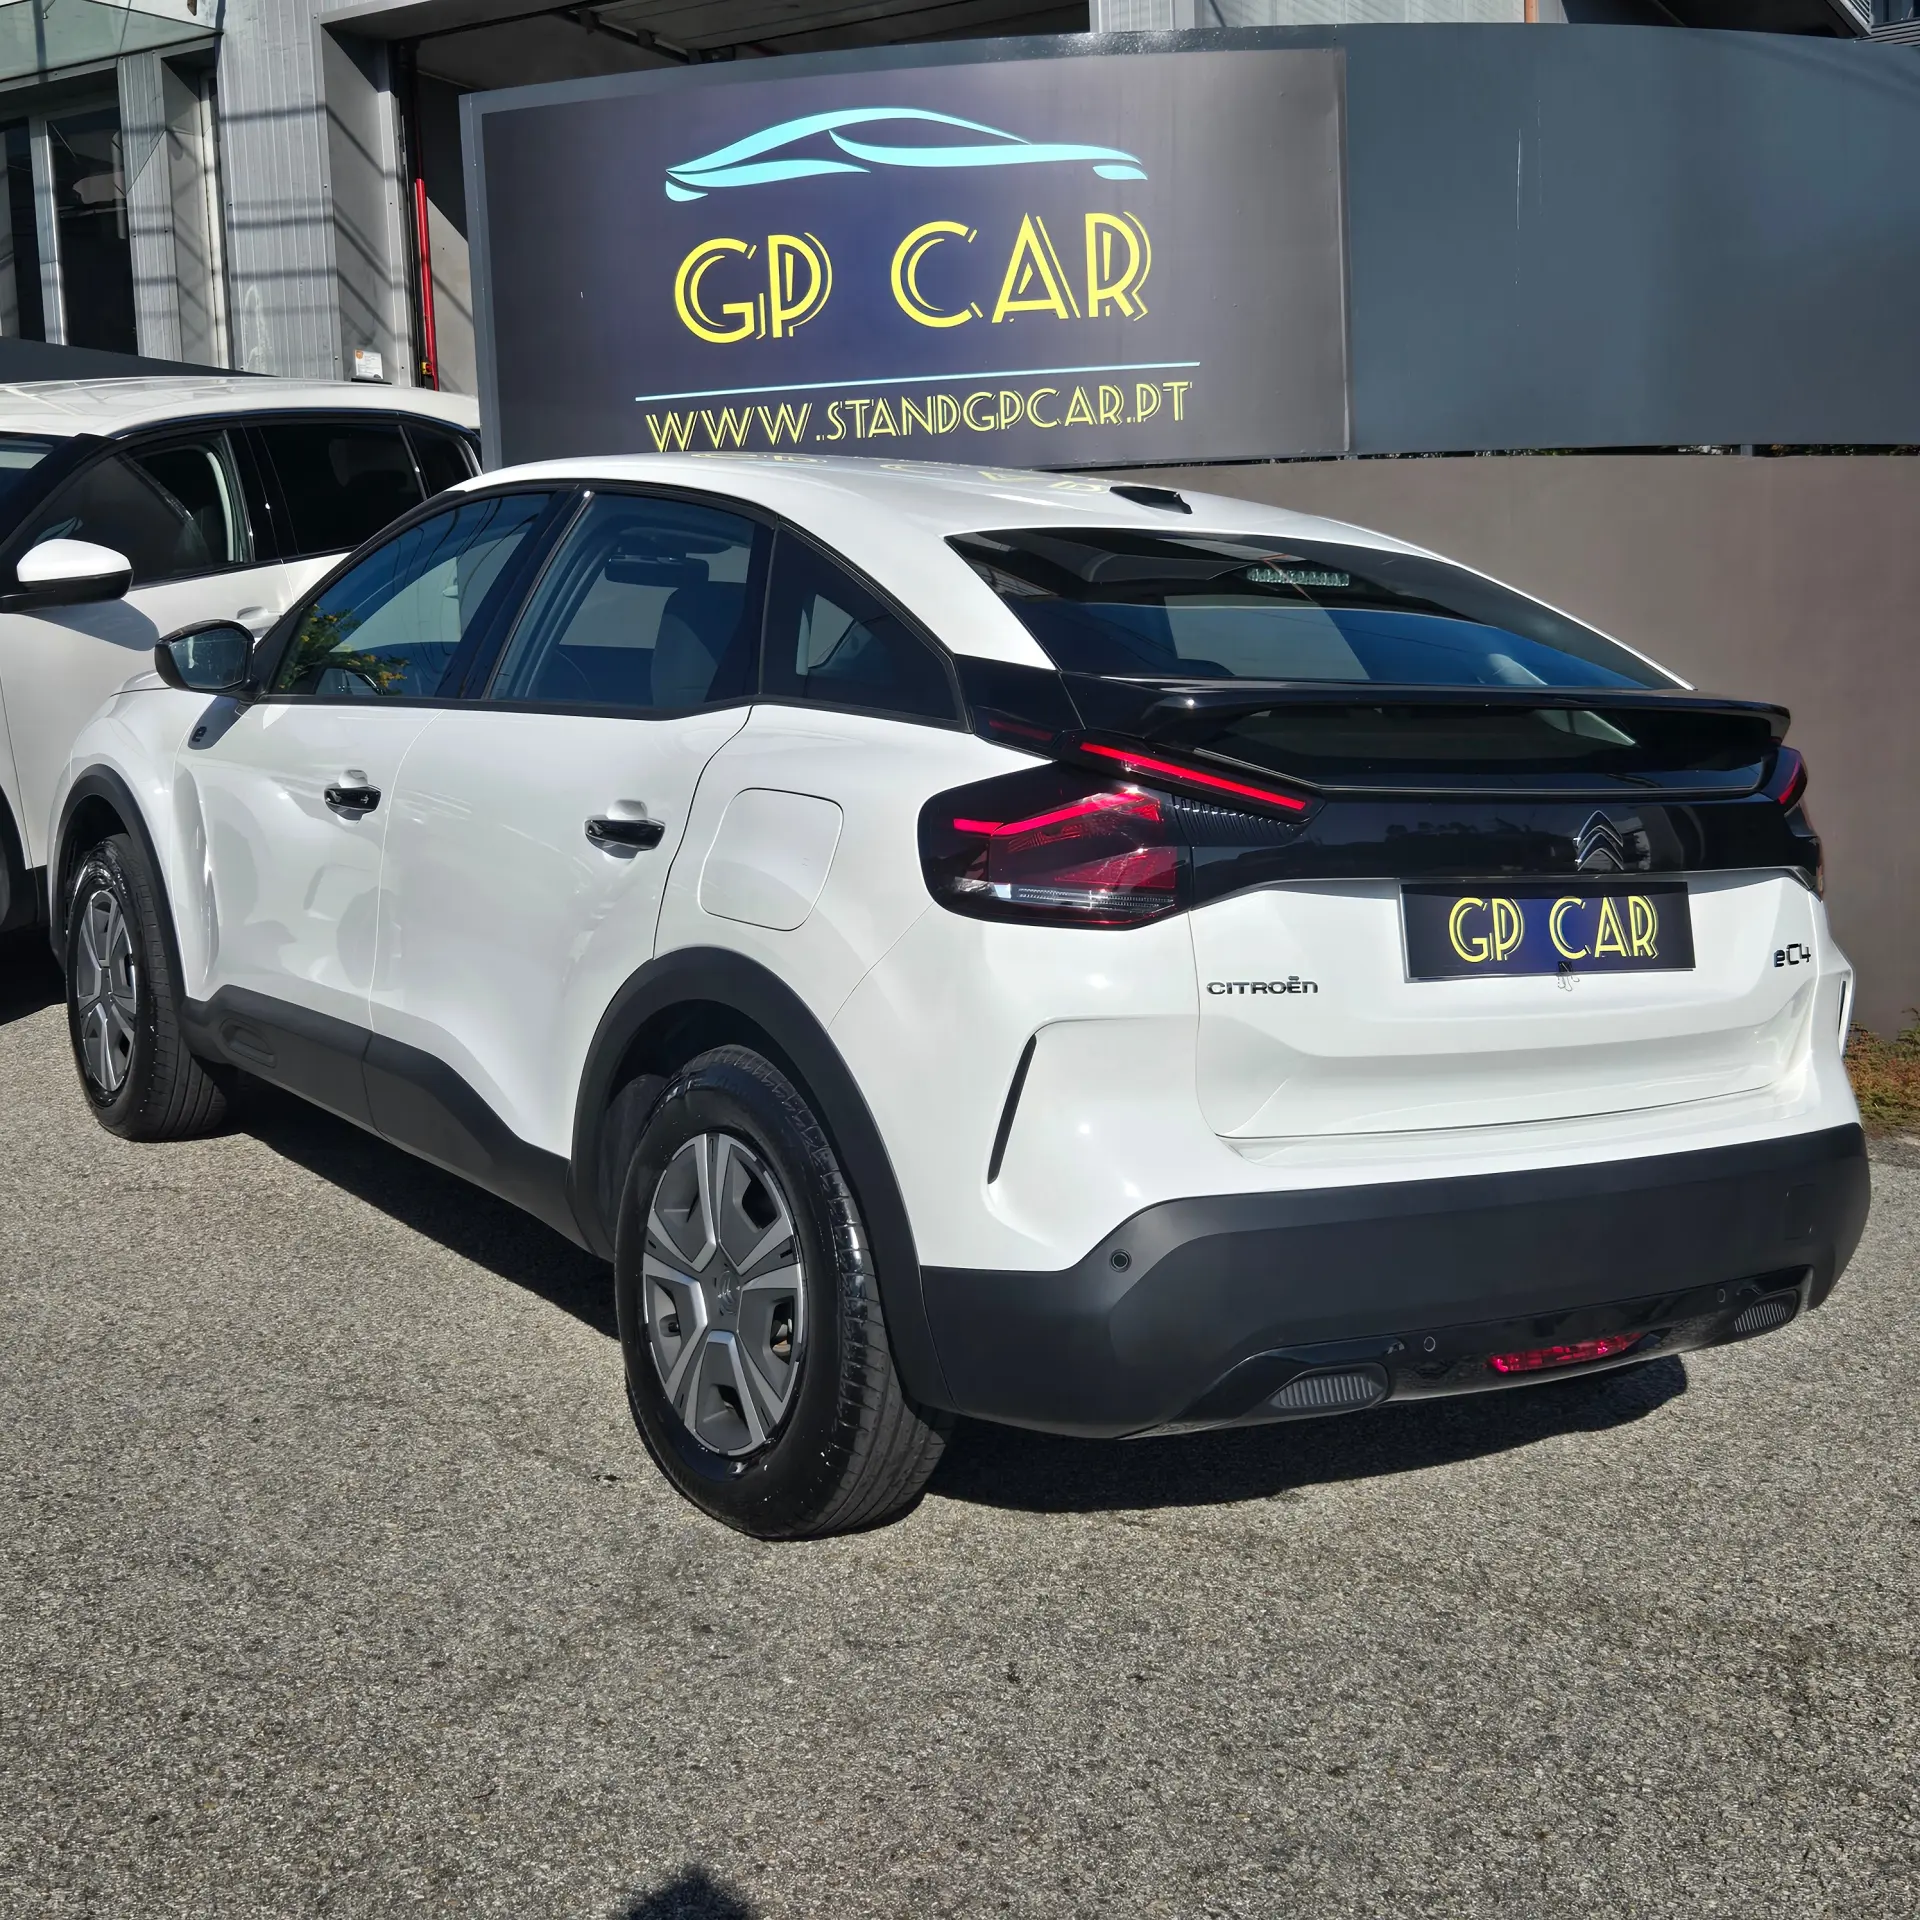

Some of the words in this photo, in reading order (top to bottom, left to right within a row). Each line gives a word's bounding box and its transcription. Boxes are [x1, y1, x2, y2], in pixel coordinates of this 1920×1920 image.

[674, 232, 833, 343] GP
[891, 211, 1152, 328] CAR
[645, 381, 1192, 453] WWW.STANDGPCAR.PT
[1449, 896, 1525, 963] GP
[1549, 895, 1659, 960] CAR
[1773, 943, 1811, 968] eC4
[1206, 976, 1318, 995] CITROËN
